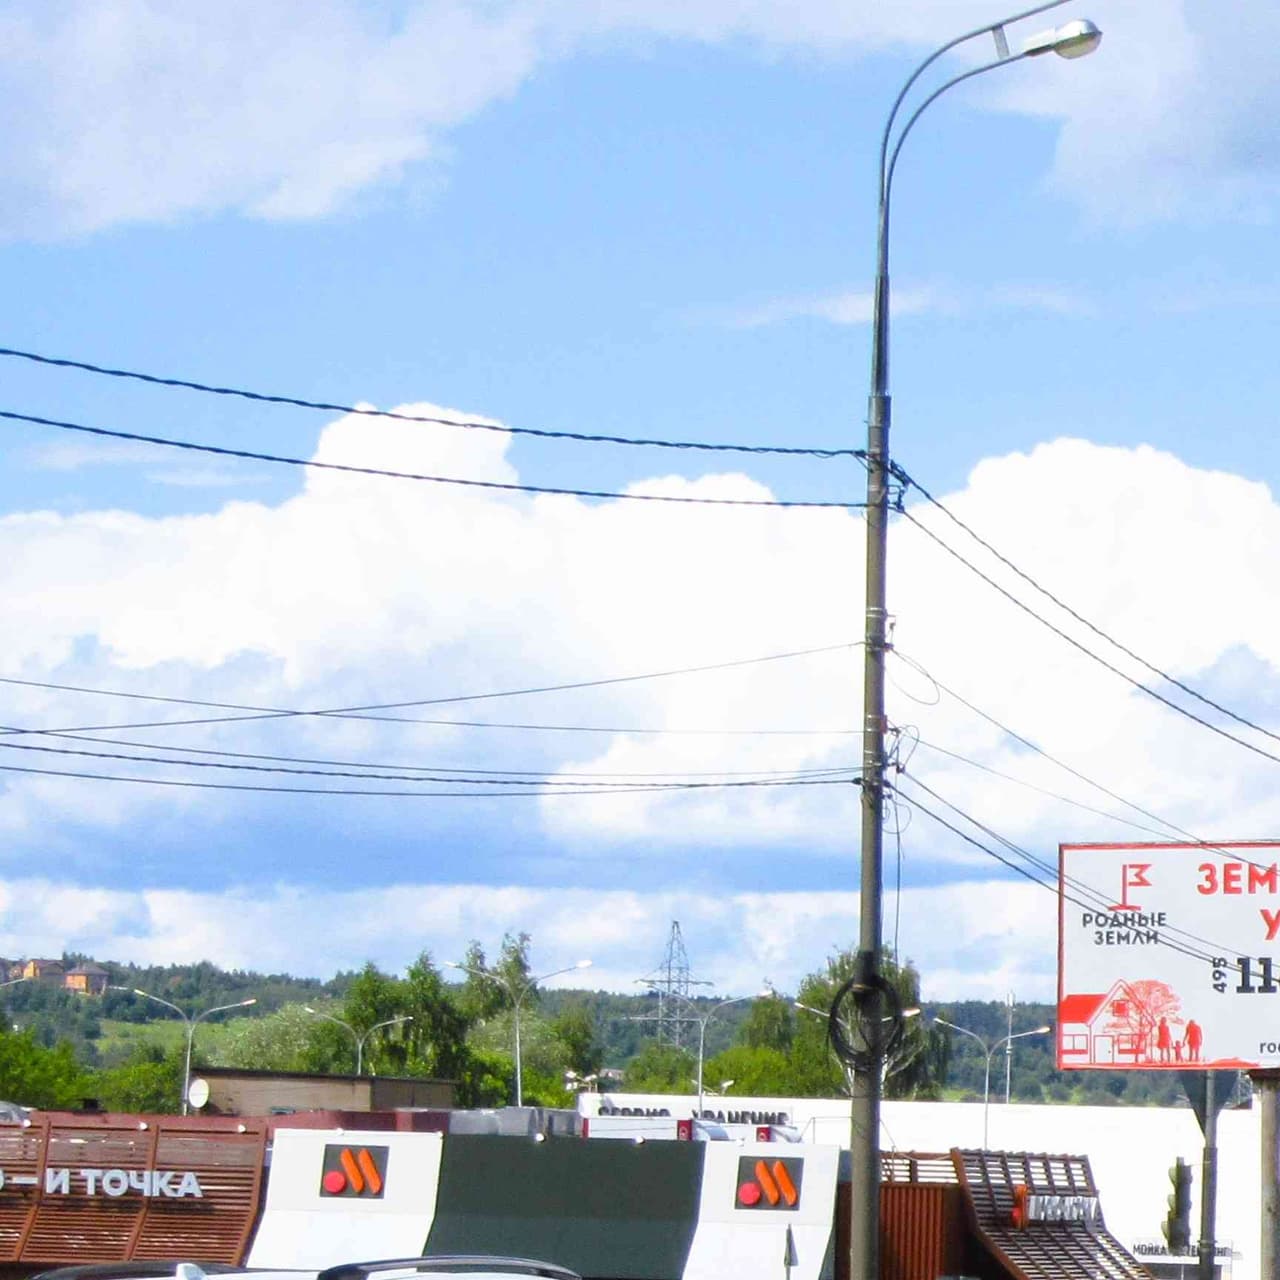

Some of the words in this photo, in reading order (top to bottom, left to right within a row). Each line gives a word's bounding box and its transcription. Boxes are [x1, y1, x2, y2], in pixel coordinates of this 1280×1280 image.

[1082, 912, 1167, 928] РОДНЫЕ
[1094, 930, 1159, 945] ЗЕМЛИ
[1213, 956, 1228, 993] 495
[46, 1167, 70, 1194] И
[80, 1168, 203, 1198] ТОЧКА
[1133, 1243, 1167, 1256] МОЙКА
